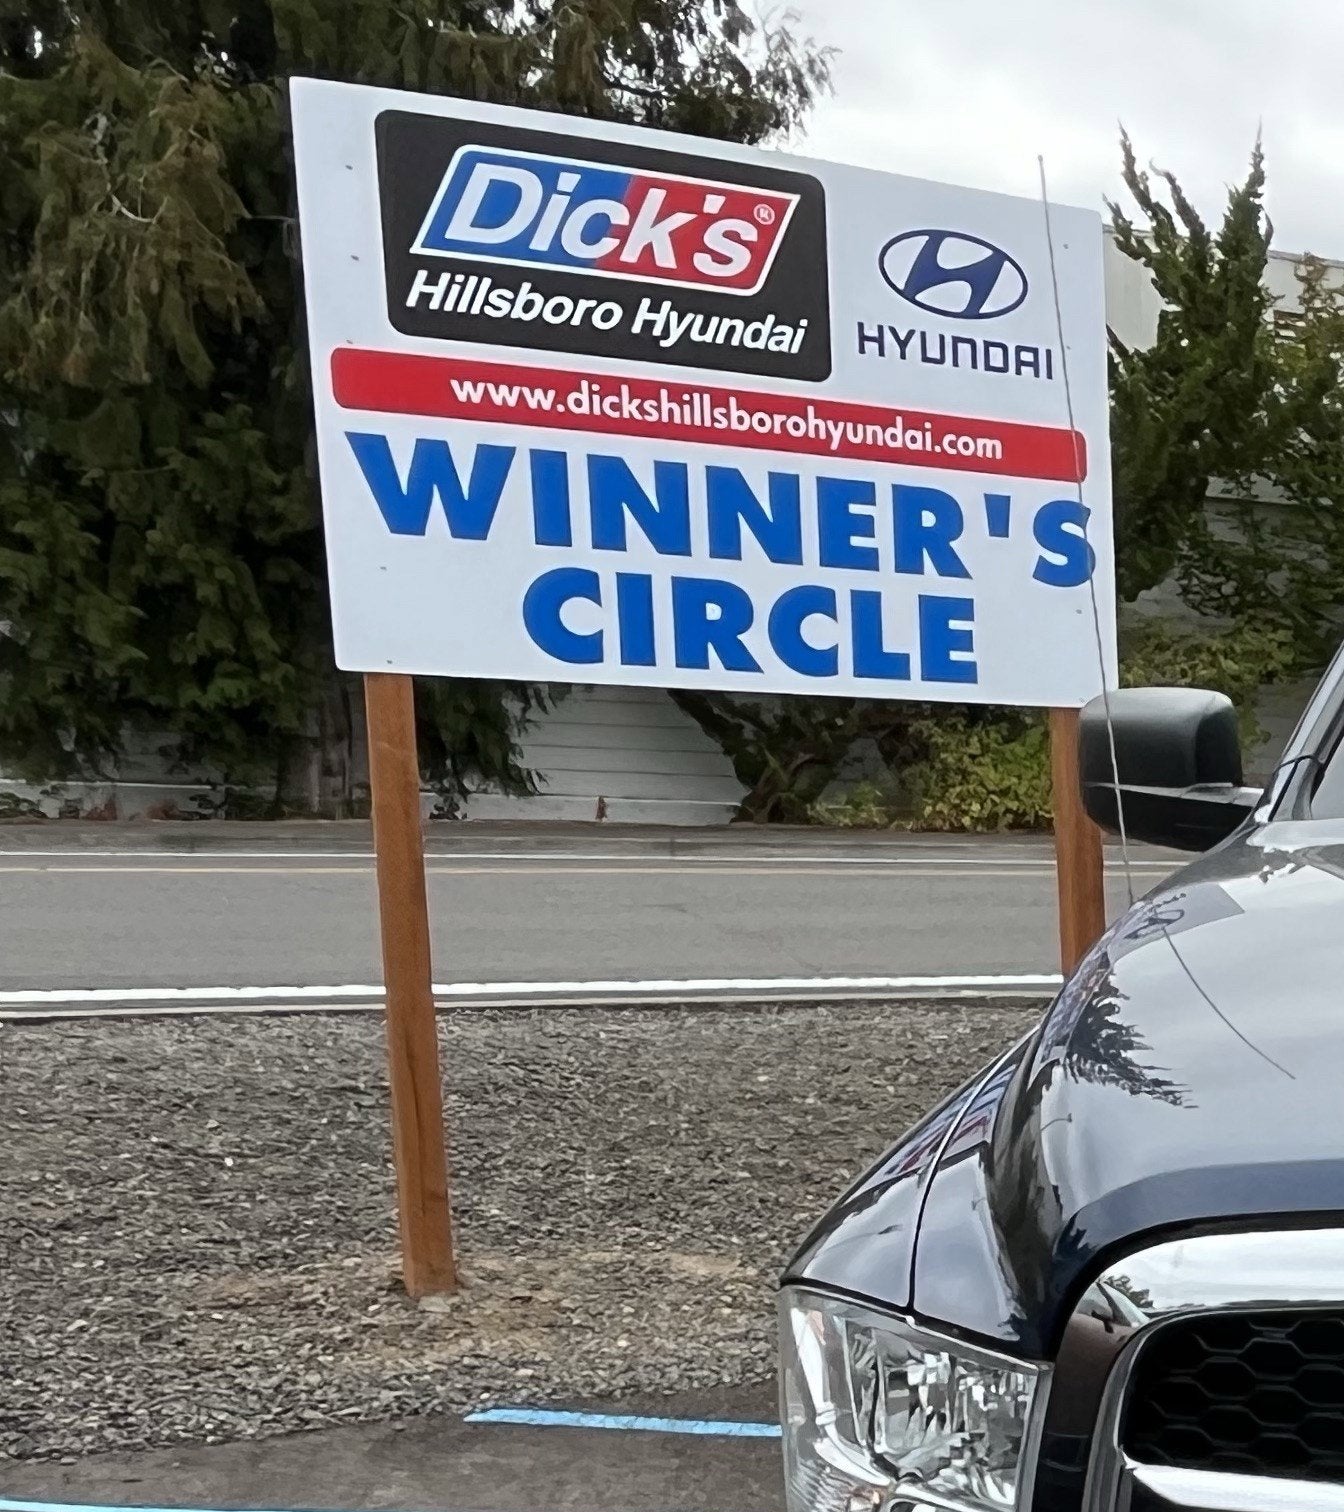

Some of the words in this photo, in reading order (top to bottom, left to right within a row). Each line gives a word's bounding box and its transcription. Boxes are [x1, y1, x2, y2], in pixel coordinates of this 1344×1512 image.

[444, 161, 759, 277] Dick's
[406, 269, 623, 330] Hillsboro
[631, 298, 809, 354] Hyundai
[857, 321, 1054, 380] HYUNDAI
[451, 375, 1003, 461] www.dickshillsborohyundai.com
[344, 431, 1096, 588] WINNER'S
[522, 565, 979, 685] CIRCLE
